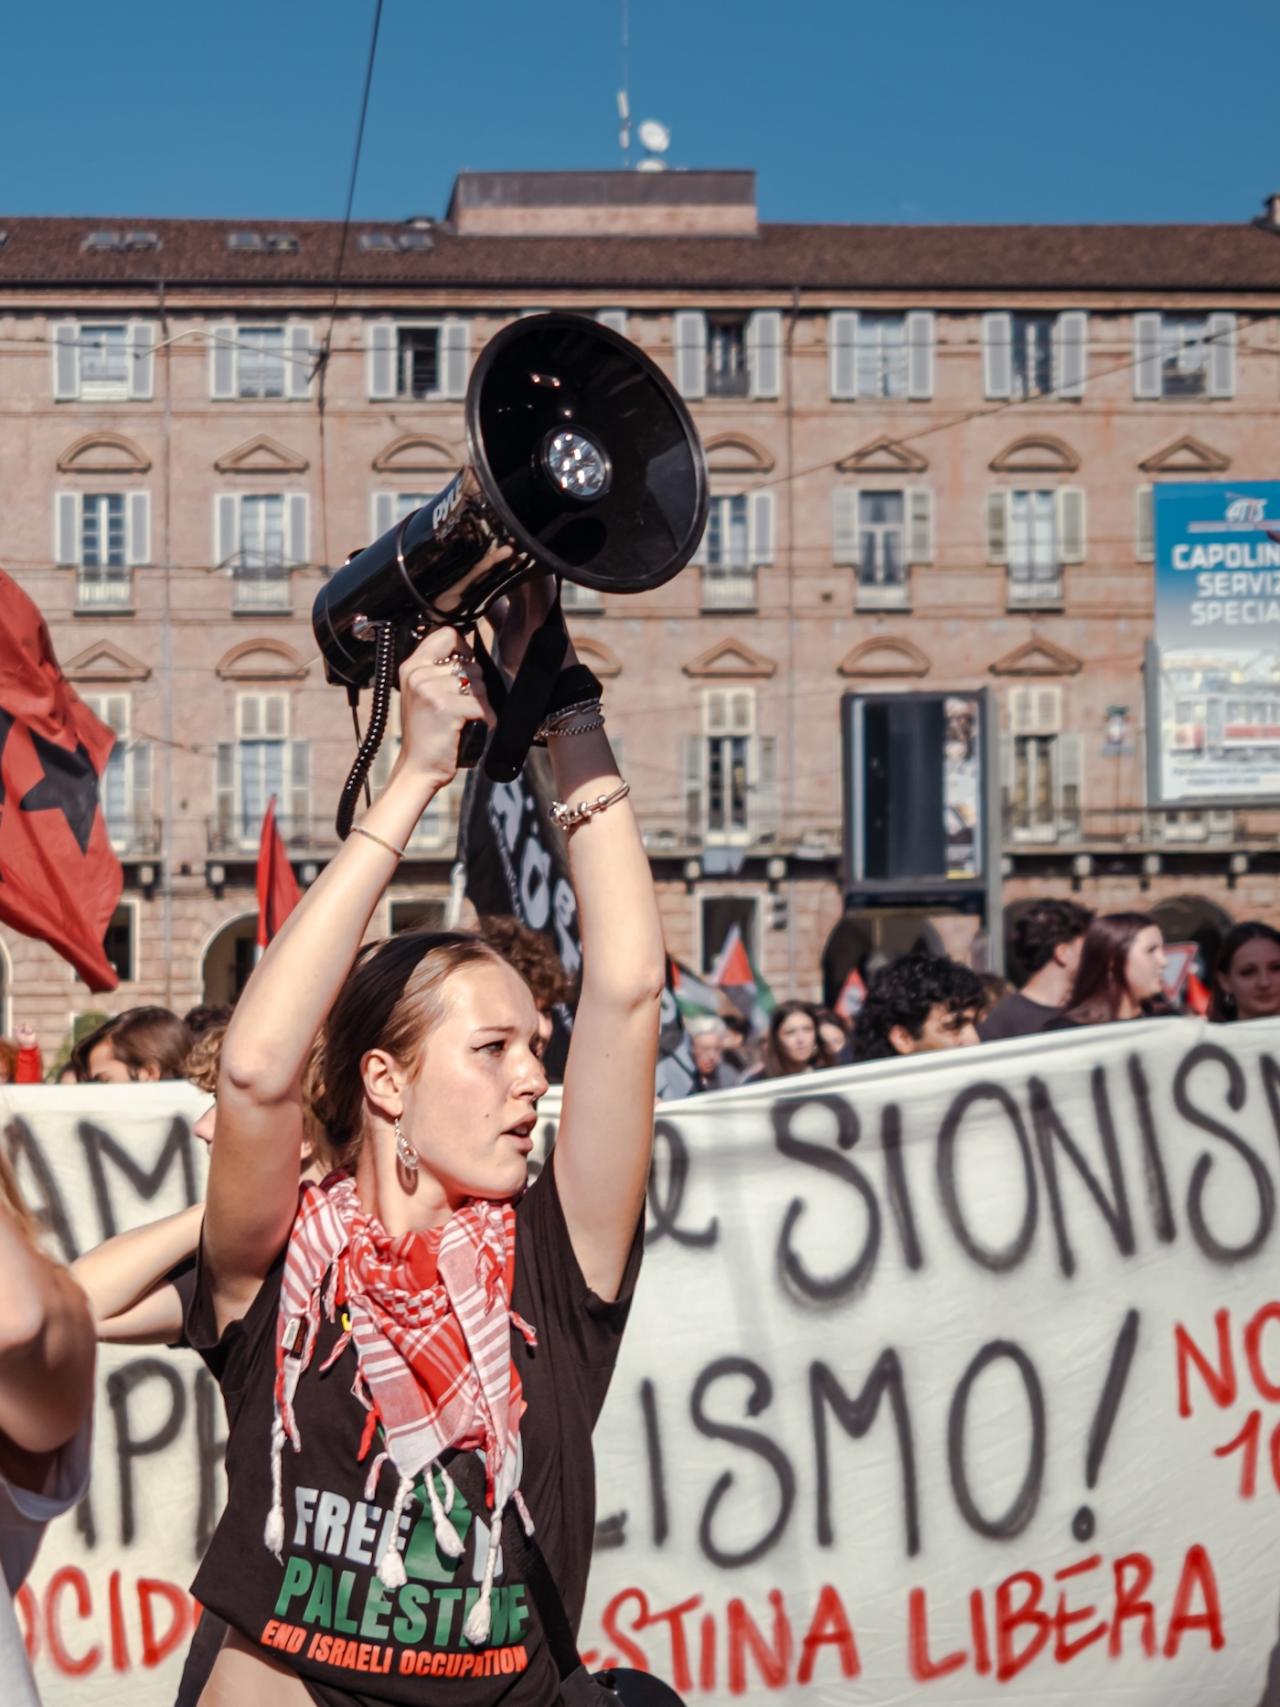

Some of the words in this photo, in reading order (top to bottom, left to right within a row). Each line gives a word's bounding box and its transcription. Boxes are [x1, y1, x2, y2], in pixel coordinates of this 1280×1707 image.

[260, 1618, 308, 1654] END
[306, 1632, 394, 1675] ISRAELI
[398, 1645, 529, 1678] OCCUPATION
